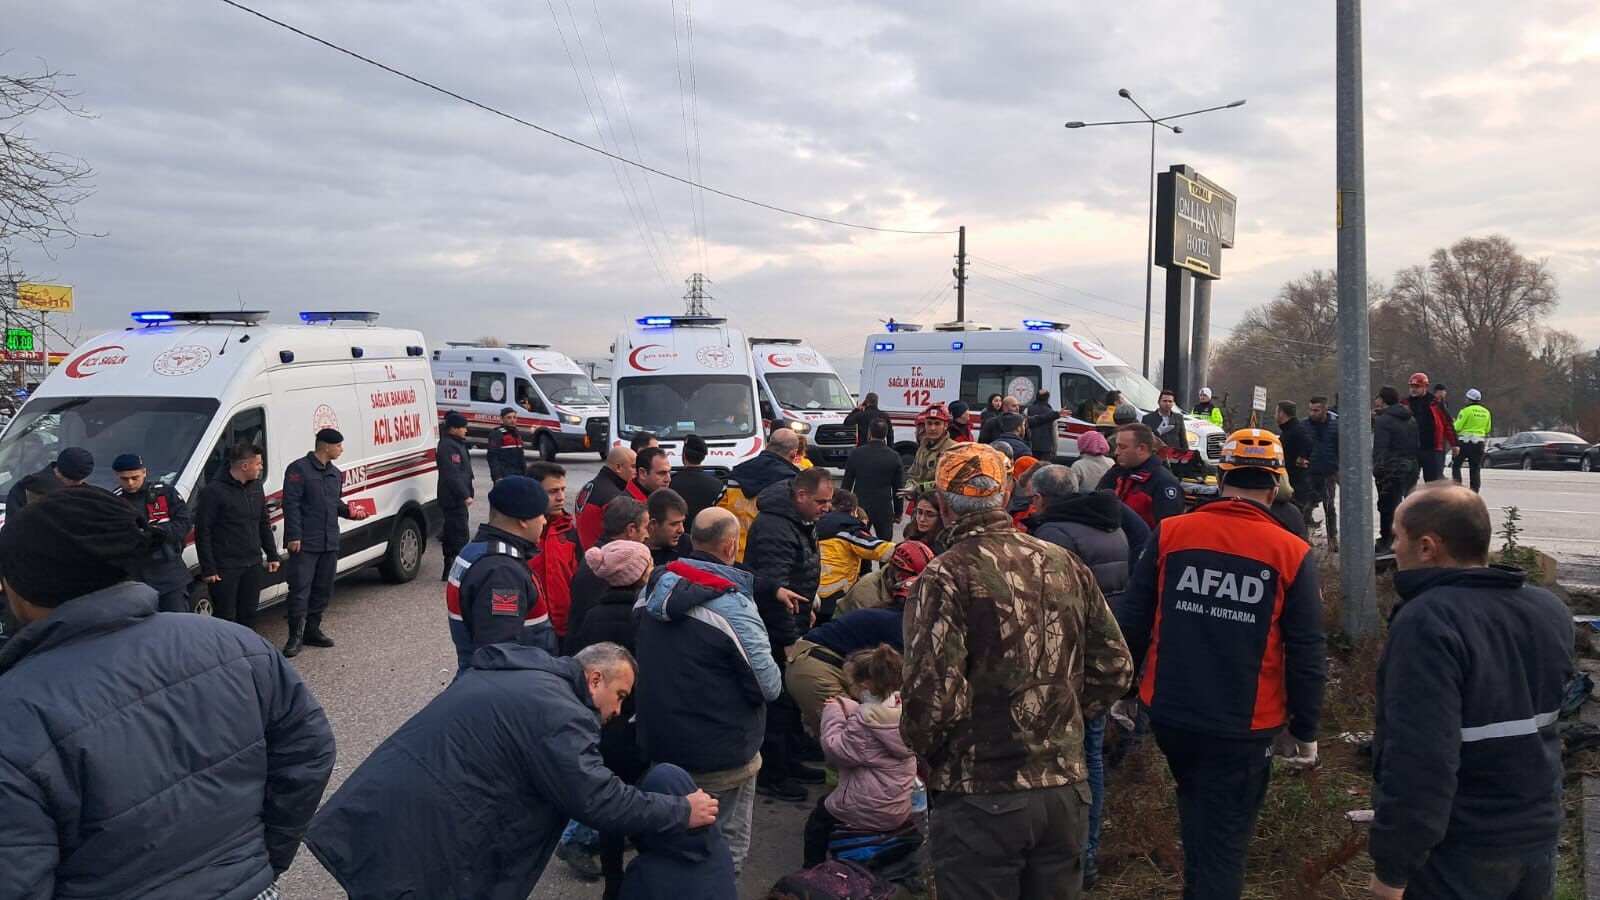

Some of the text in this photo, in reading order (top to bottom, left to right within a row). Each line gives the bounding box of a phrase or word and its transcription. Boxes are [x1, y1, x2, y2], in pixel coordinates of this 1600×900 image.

[1186, 233, 1211, 257] HOTEL
[888, 376, 946, 389] SAĞLIK BAKANLIĞI
[370, 389, 390, 409] SAĞLIK
[443, 388, 458, 400] 112
[904, 389, 931, 406] 112
[374, 410, 422, 446] ACİL SAĞLIK
[1176, 565, 1265, 604] AFAD
[1175, 600, 1204, 615] ARAMA
[1210, 606, 1256, 624] KURTARMA
